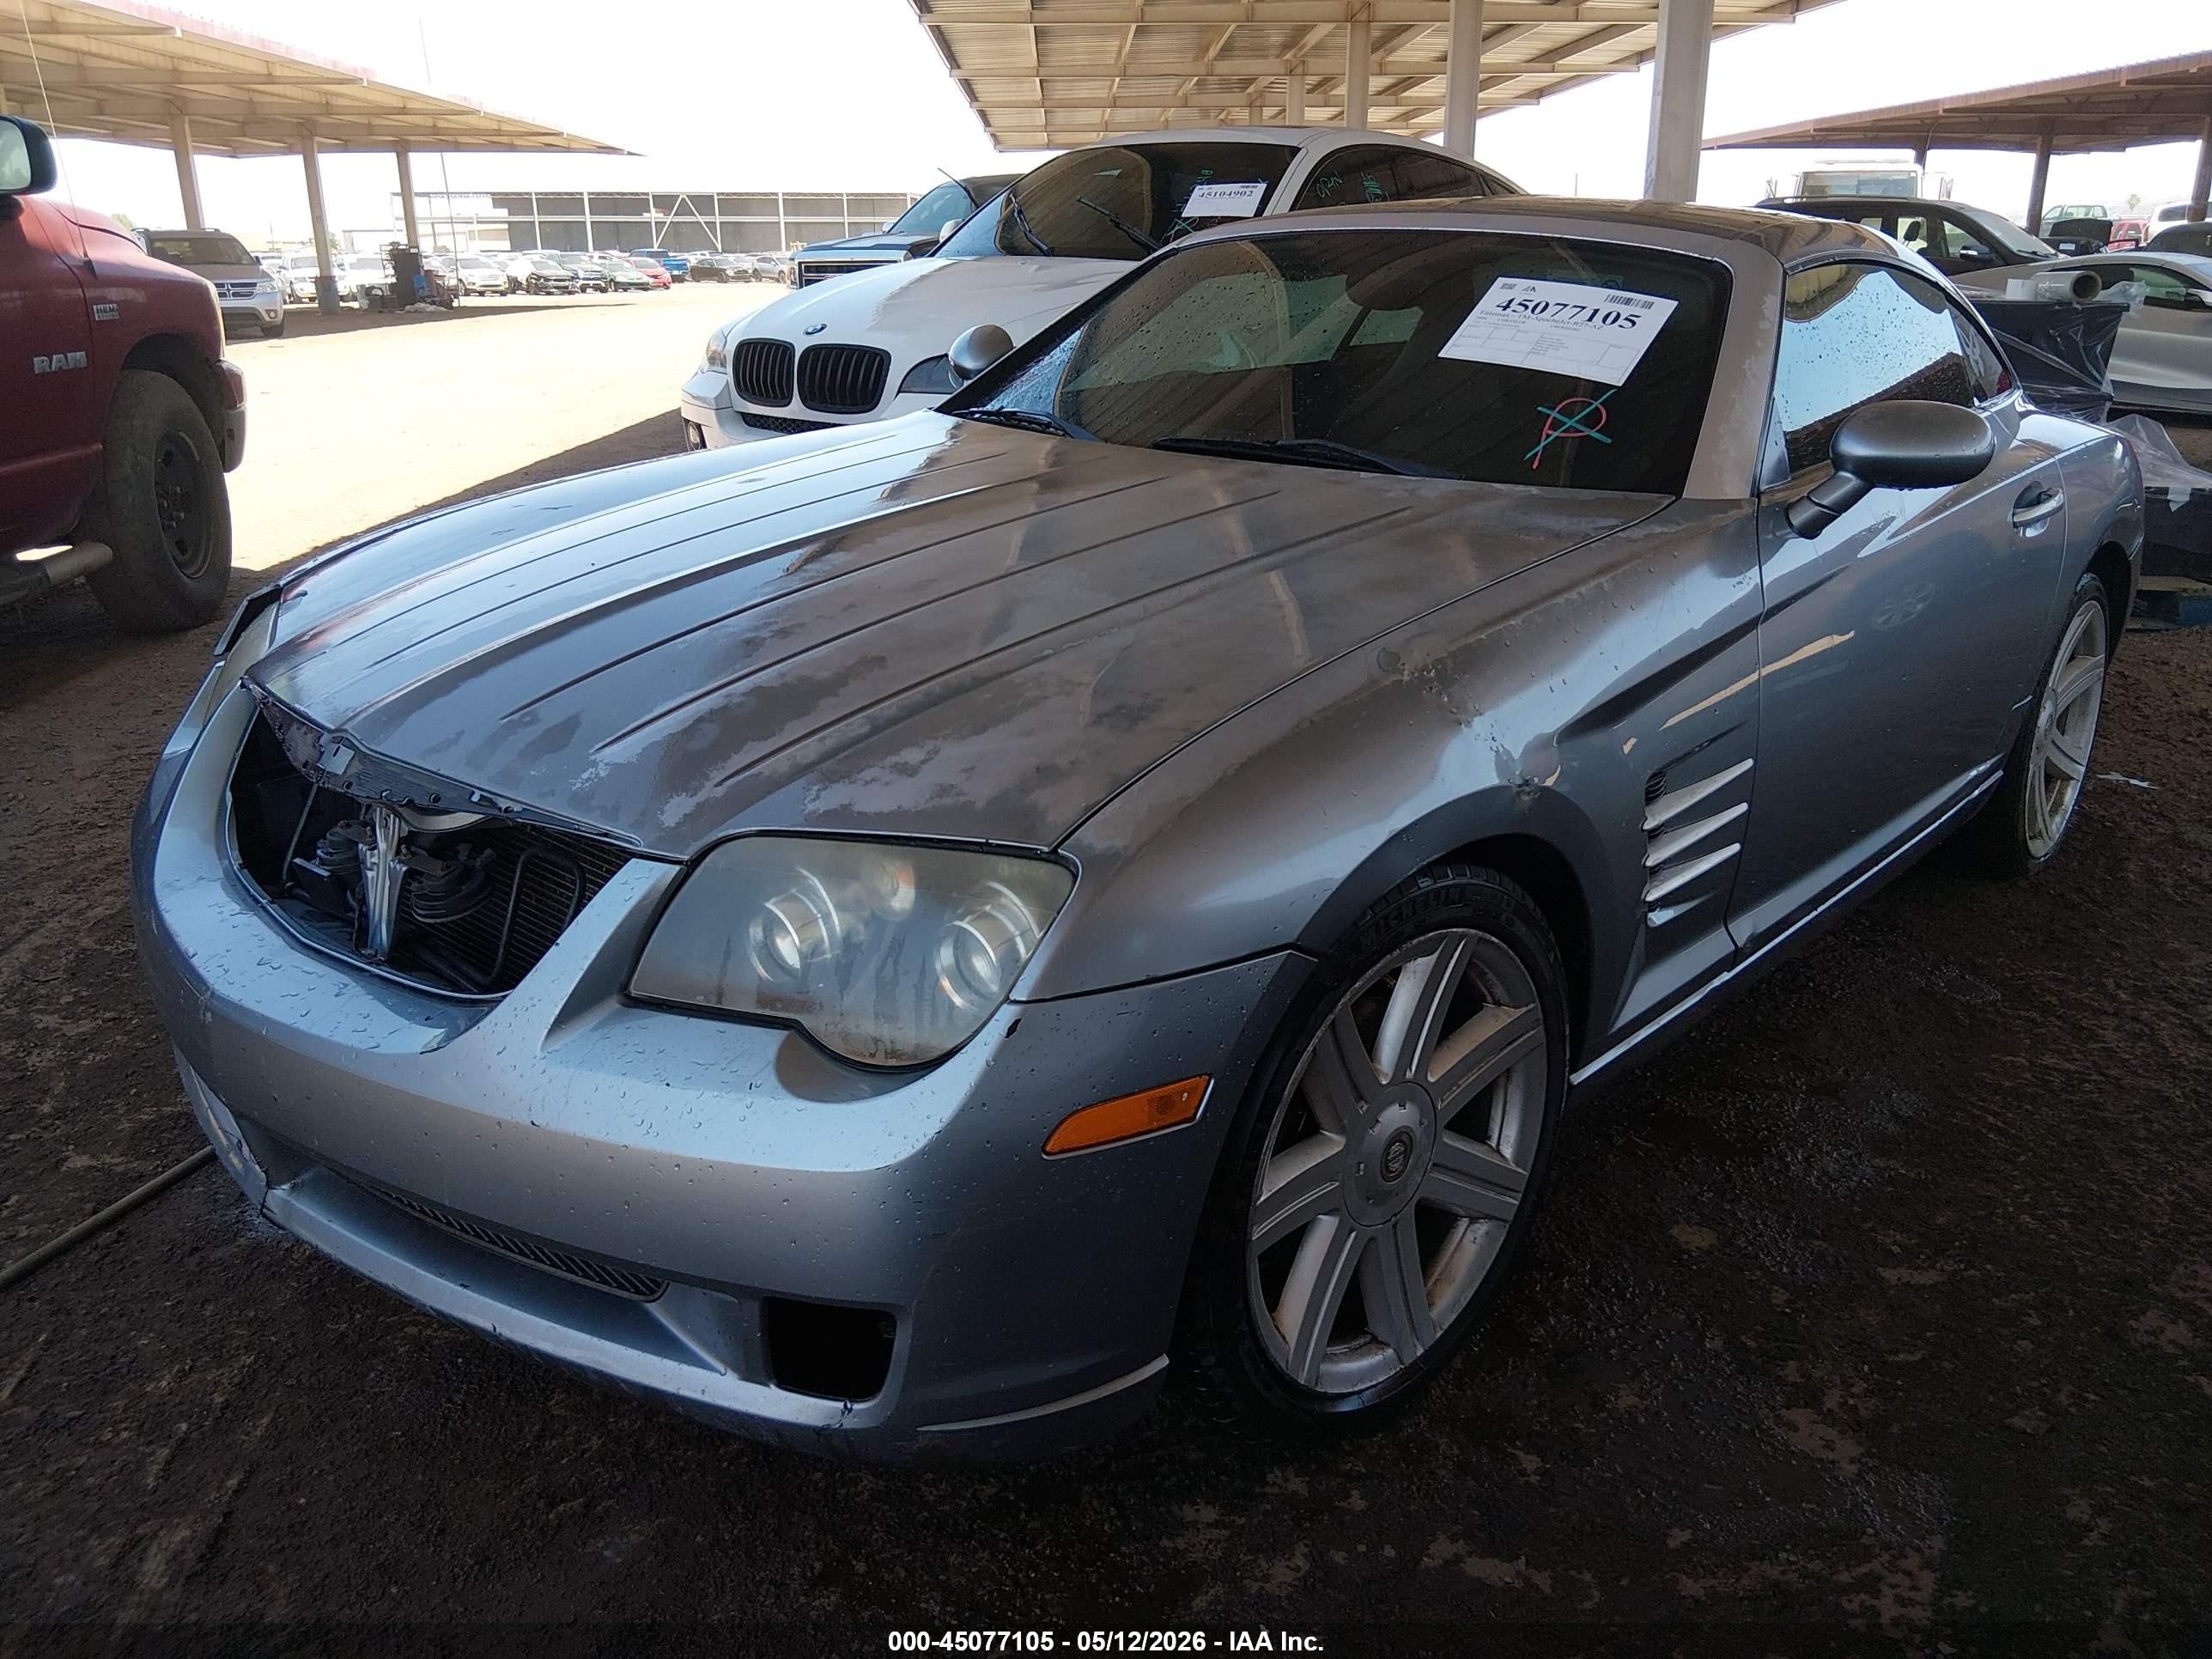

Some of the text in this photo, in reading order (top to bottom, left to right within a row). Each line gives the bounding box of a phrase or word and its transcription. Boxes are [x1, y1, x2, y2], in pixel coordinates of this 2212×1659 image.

[1198, 190, 1254, 198] 45104902
[96, 305, 118, 314] HEMI
[1496, 297, 1642, 330] 45077105
[33, 351, 87, 374] RAM
